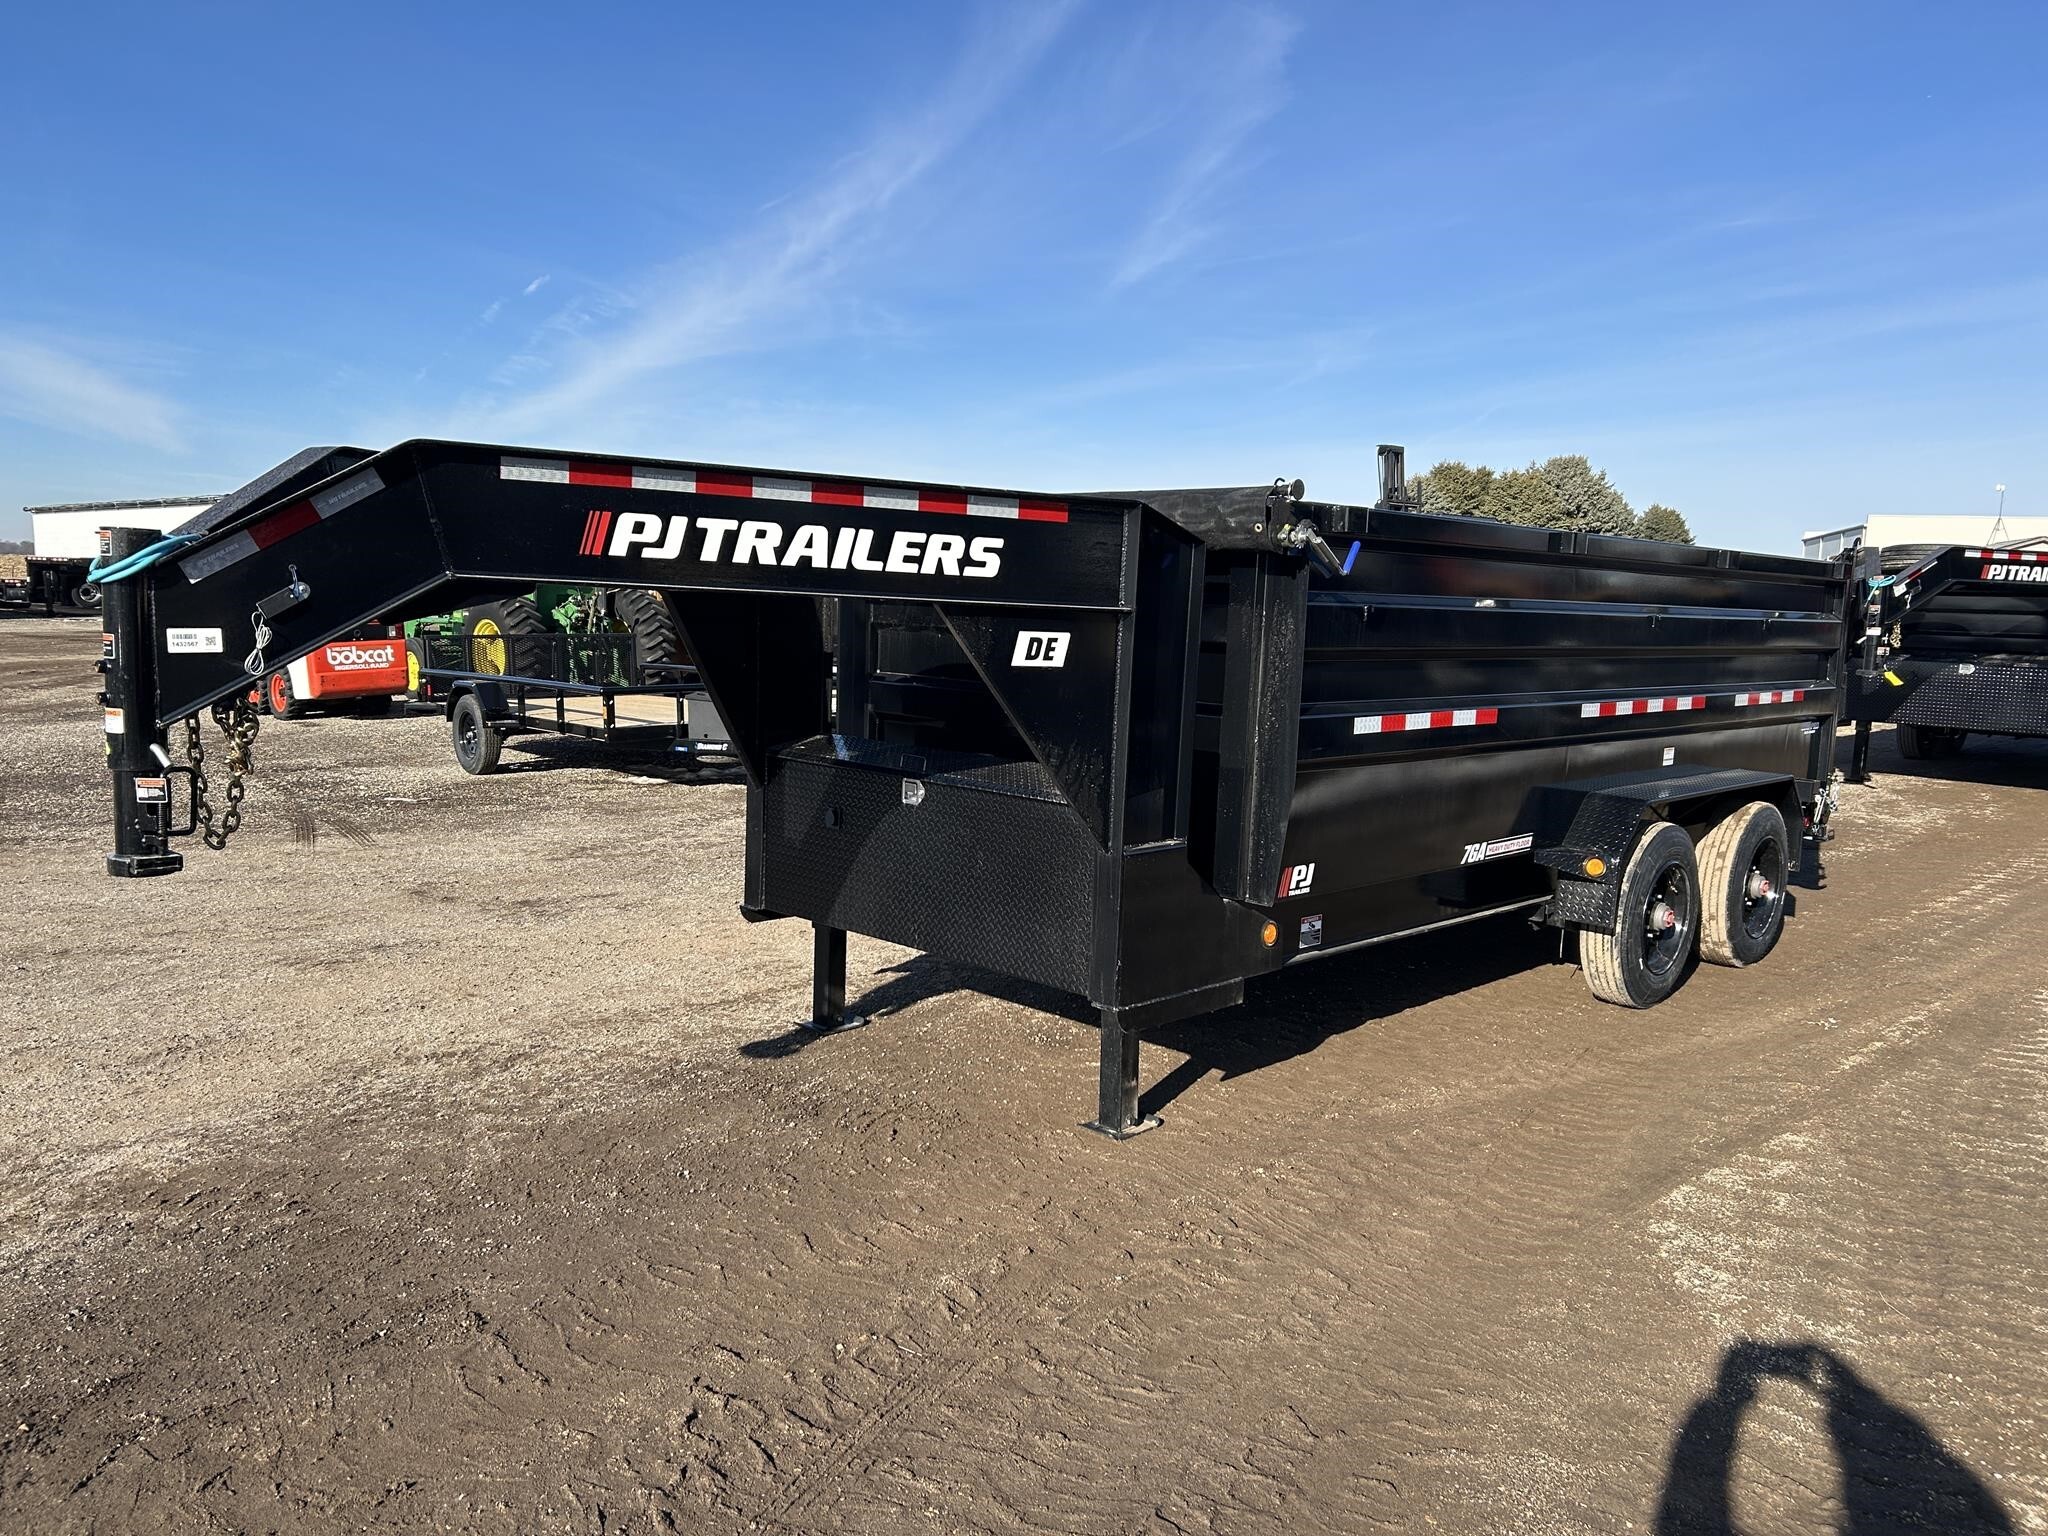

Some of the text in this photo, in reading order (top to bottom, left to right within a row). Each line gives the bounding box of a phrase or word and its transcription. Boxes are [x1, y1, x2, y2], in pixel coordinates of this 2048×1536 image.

[608, 512, 1005, 578] PJ TRAILERS
[1986, 564, 2048, 582] PJ TRAI
[326, 645, 395, 665] bobcat
[1025, 637, 1058, 661] DE
[1460, 841, 1487, 865] 7GA
[1488, 844, 1504, 853] HEAVY
[1290, 863, 1315, 889] PJ
